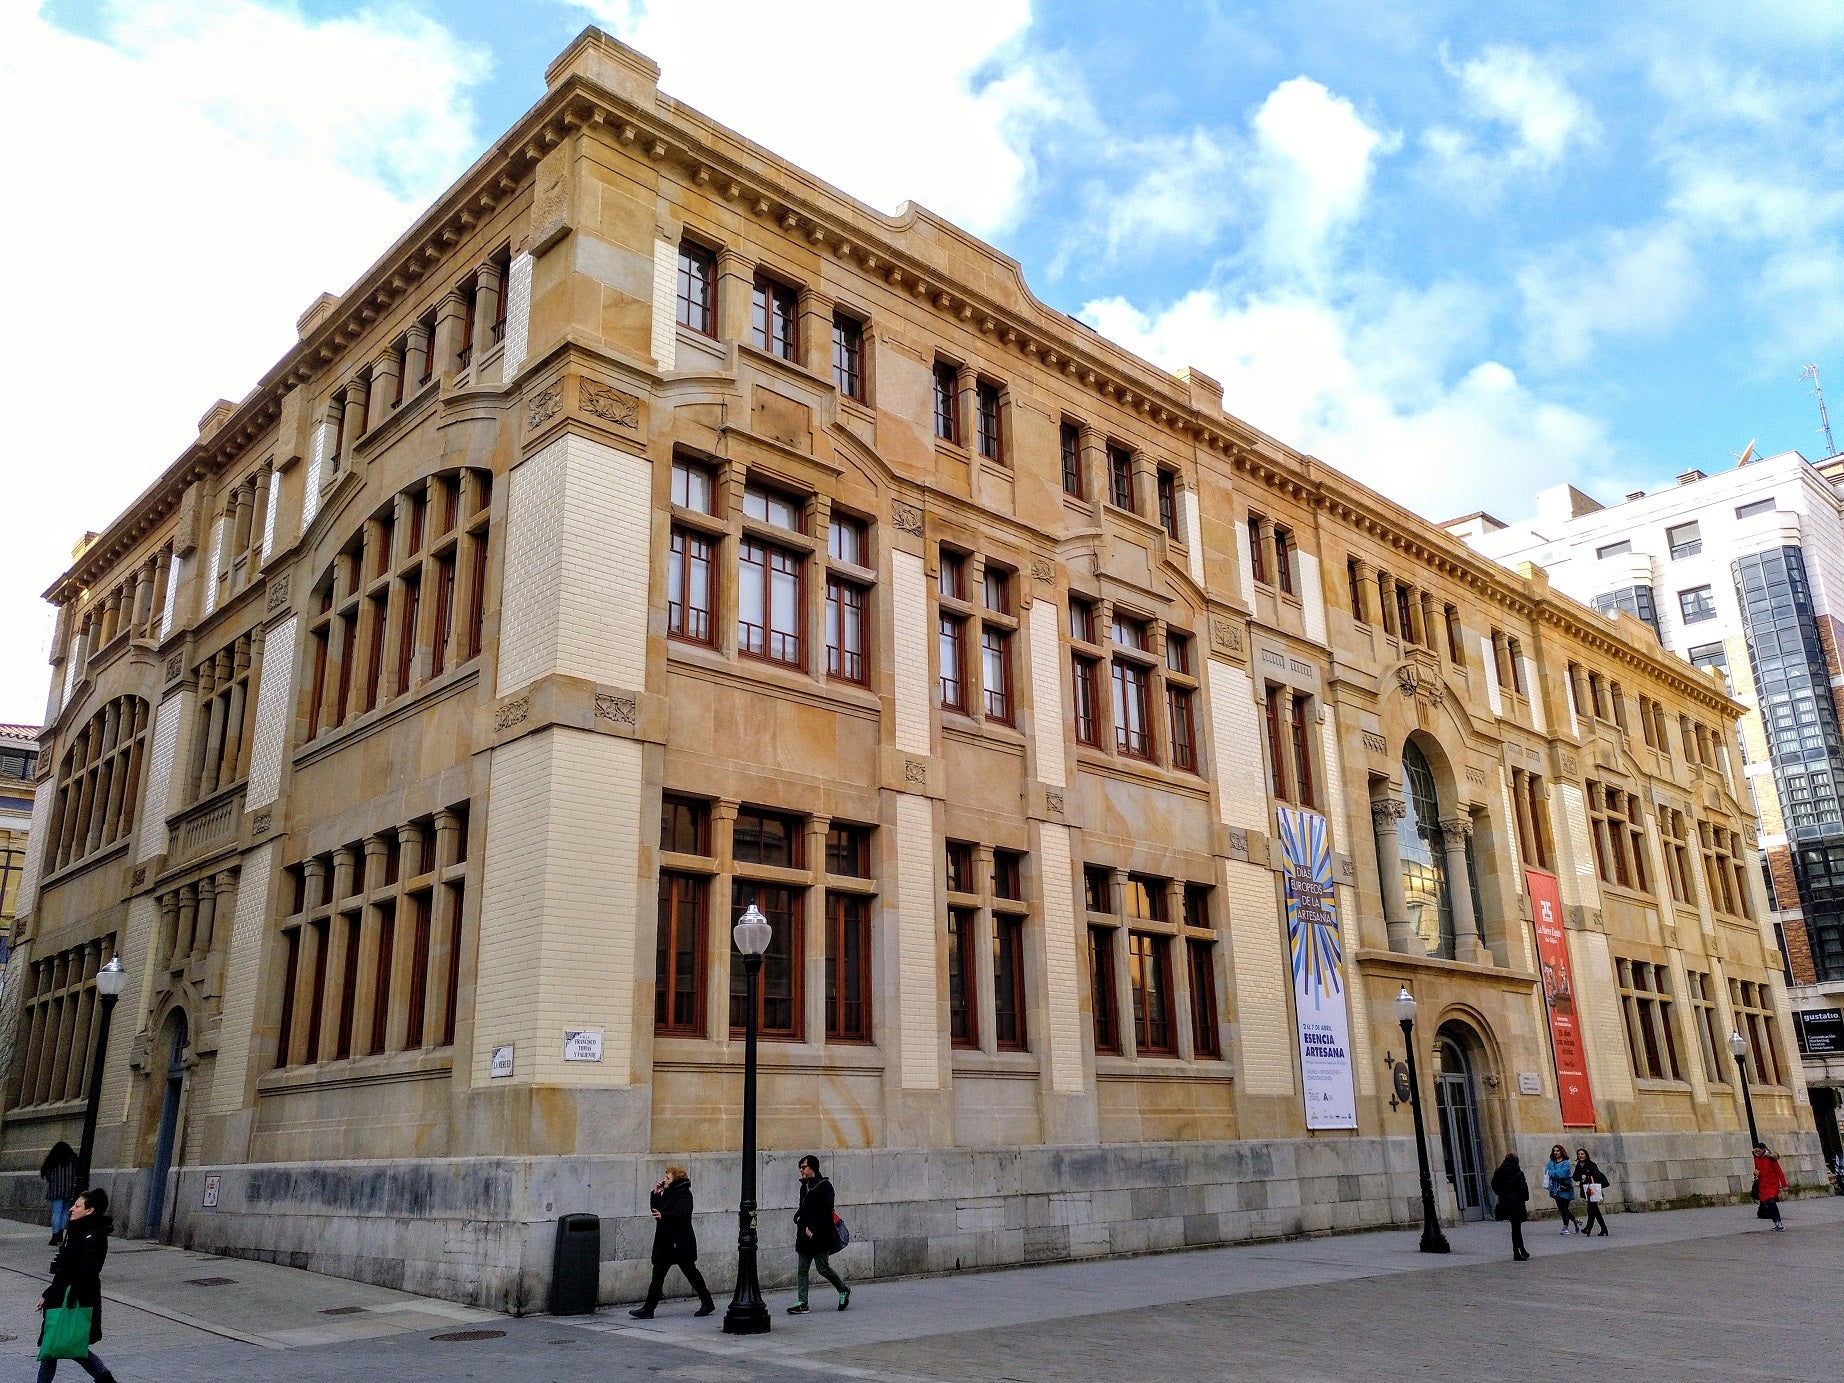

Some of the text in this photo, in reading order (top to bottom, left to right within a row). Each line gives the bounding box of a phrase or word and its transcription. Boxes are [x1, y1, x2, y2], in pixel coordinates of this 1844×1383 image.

[1296, 866, 1312, 879] DÍAS
[1290, 880, 1323, 895] EUROPEOS
[1301, 895, 1321, 908] DE LA
[1297, 909, 1332, 924] ARTESANÍA
[1303, 1033, 1336, 1045] ESENCIA
[1305, 1046, 1345, 1058] ARTESANA
